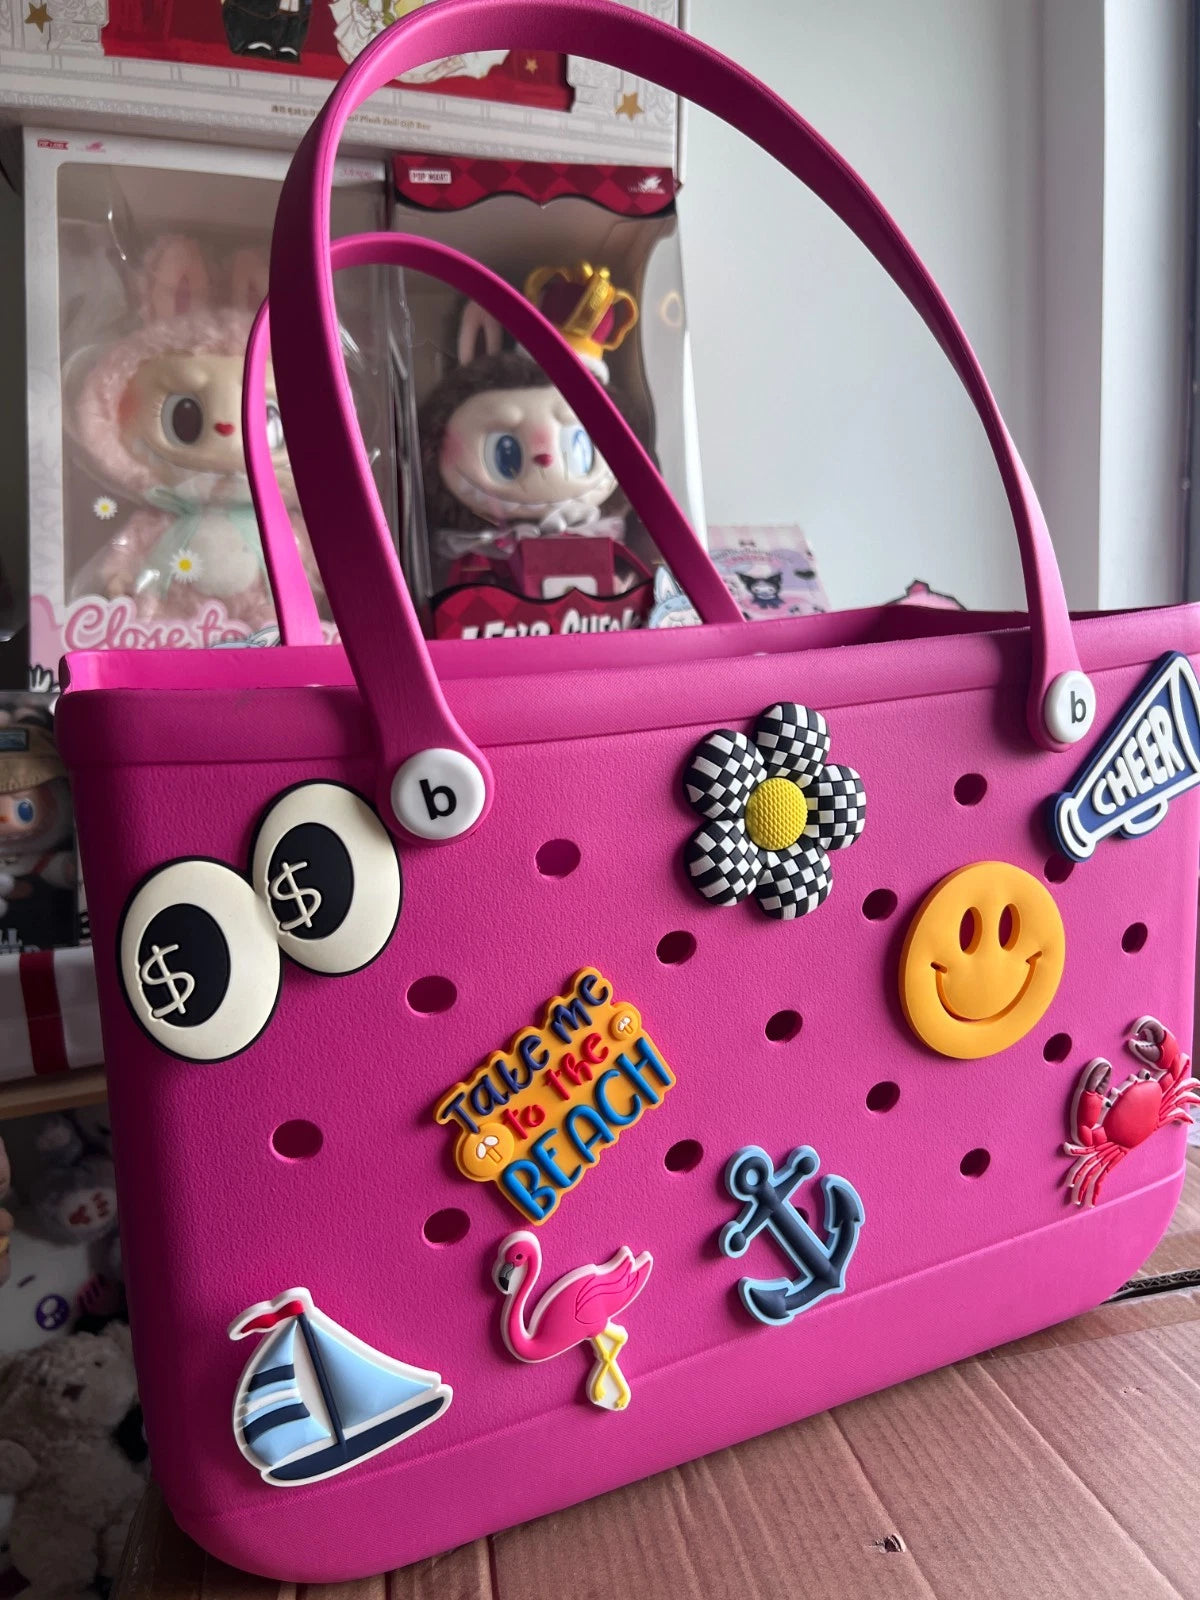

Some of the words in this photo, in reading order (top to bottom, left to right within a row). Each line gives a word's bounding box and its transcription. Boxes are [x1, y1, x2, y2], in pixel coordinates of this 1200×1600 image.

[64, 603, 195, 650] Close
[1070, 690, 1087, 724] b
[419, 779, 457, 820] b
[1092, 705, 1186, 815] CHEER
[441, 1034, 550, 1134] Take
[502, 1103, 546, 1140] to
[543, 1032, 609, 1101] the
[502, 1036, 672, 1220] BEACH
